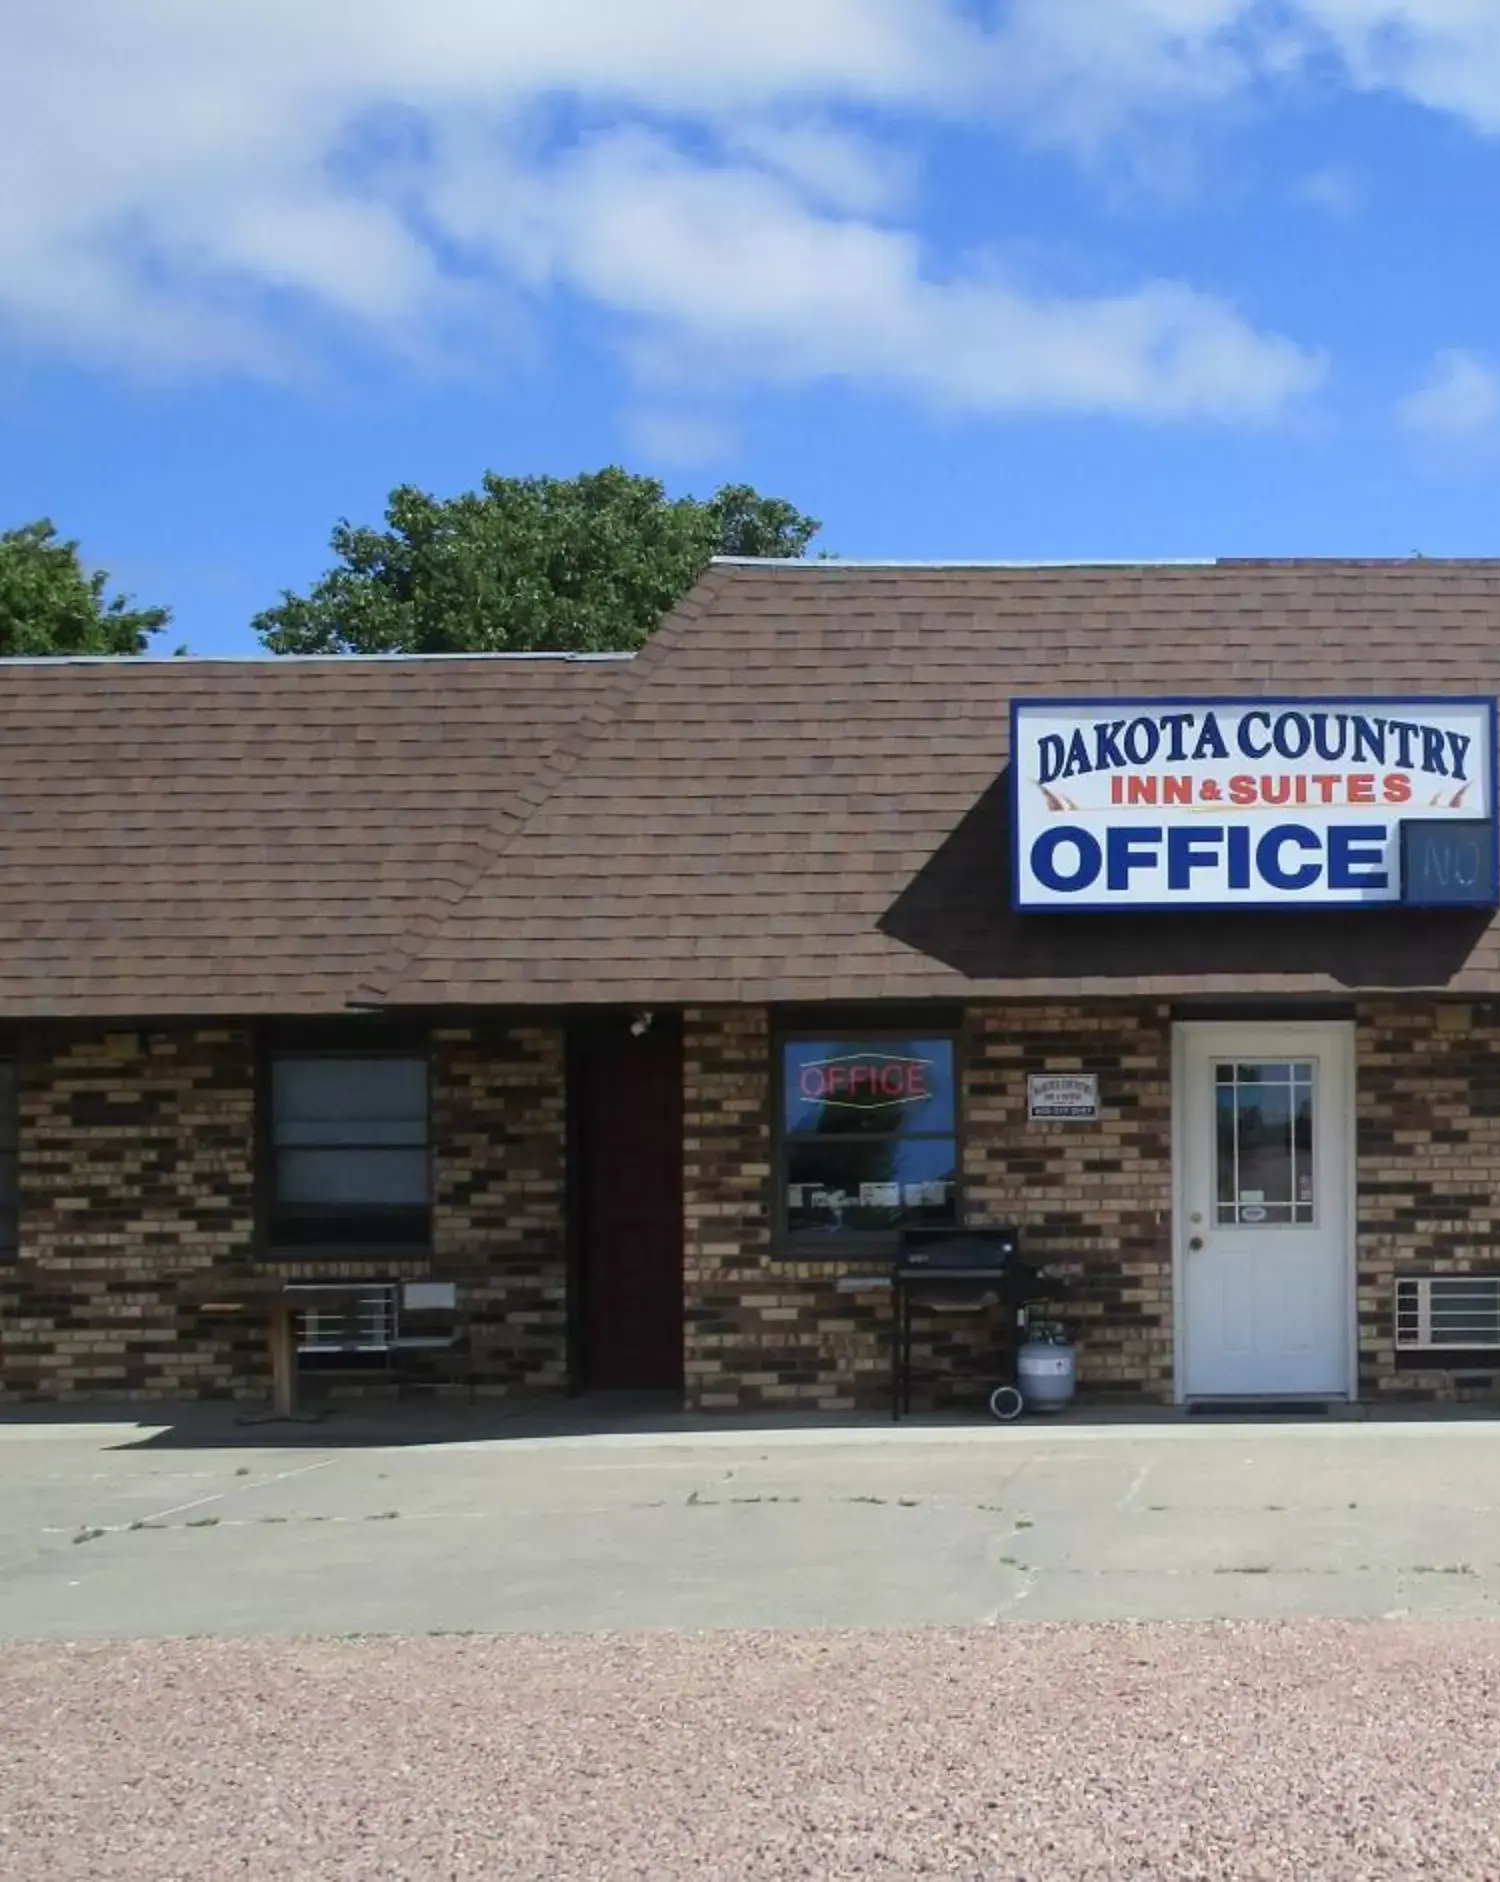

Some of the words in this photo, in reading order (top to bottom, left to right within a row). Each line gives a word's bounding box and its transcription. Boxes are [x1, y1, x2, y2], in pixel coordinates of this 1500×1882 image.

[1038, 711, 1229, 784] DAKOTA
[1237, 711, 1472, 780] COUNTRY
[1029, 824, 1389, 892] OFFICE
[800, 1063, 927, 1097] OFFICE
